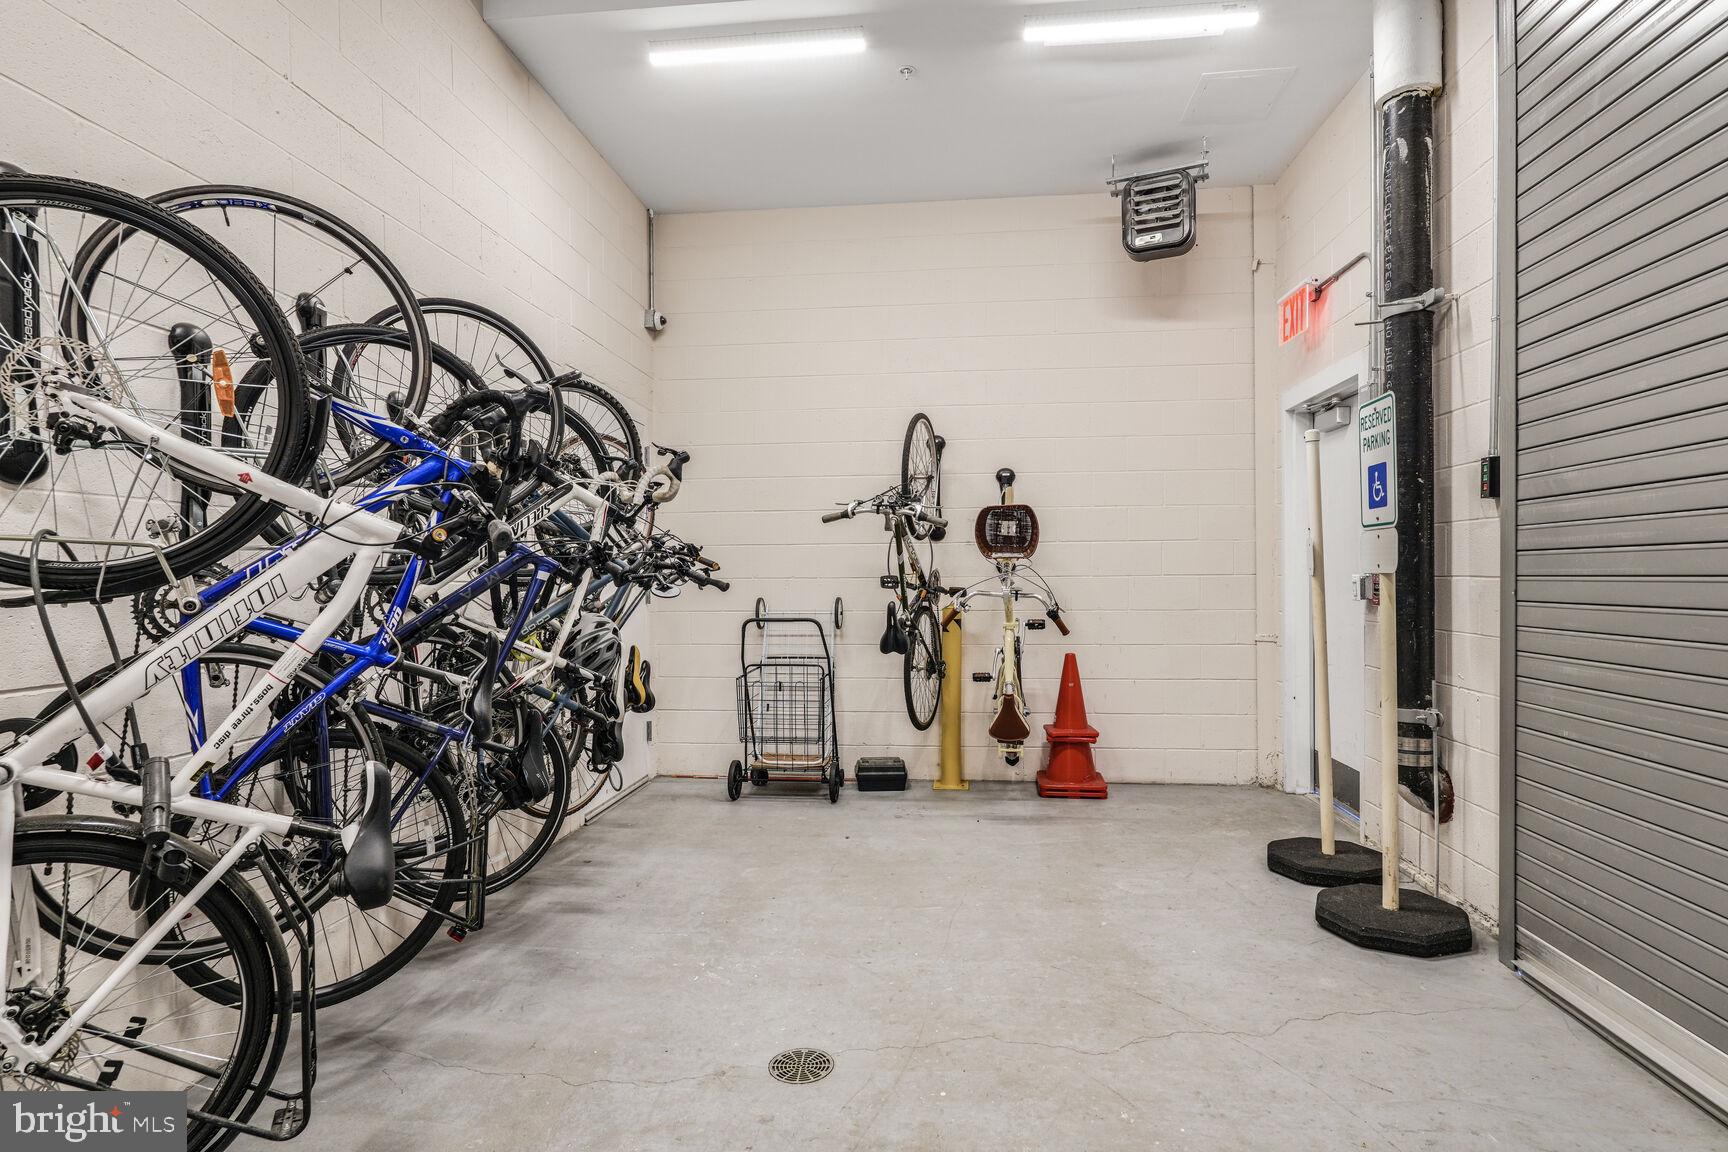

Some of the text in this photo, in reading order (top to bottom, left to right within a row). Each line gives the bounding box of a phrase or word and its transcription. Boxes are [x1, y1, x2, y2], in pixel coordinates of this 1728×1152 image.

[1282, 287, 1306, 342] EXIT
[1361, 406, 1392, 432] RESERVED
[1362, 429, 1391, 453] PARKING
[213, 683, 274, 750] boss.three disc
[283, 692, 326, 734] GIANT
